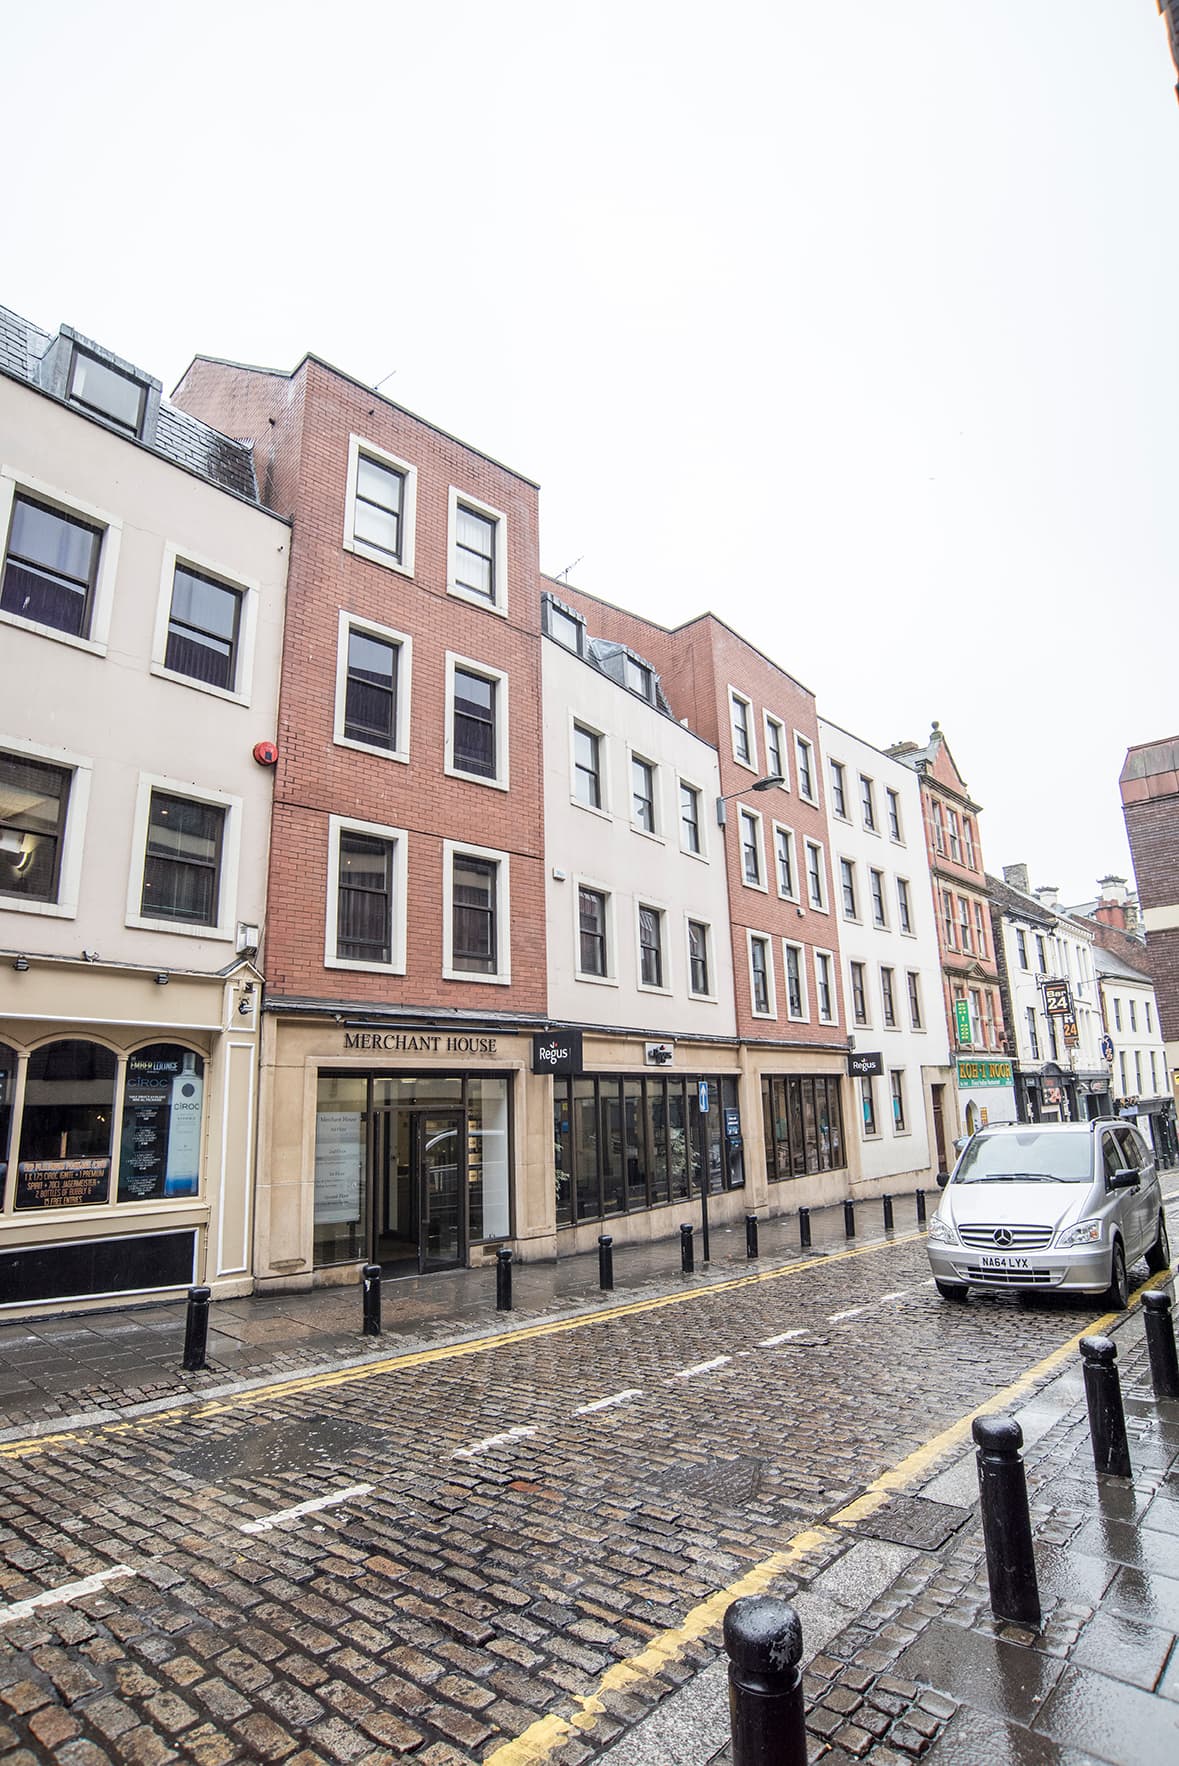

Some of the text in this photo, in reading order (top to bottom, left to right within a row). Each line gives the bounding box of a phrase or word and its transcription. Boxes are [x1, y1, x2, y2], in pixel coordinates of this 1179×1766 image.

[1048, 997, 1067, 1009] 24
[1064, 1024, 1077, 1036] 24
[344, 1033, 497, 1053] MERCHANT HOUSE
[540, 1047, 568, 1064] Regus
[853, 1061, 876, 1072] Regus
[989, 1063, 1011, 1078] NOOR
[982, 1257, 1028, 1268] NA64 LYX
